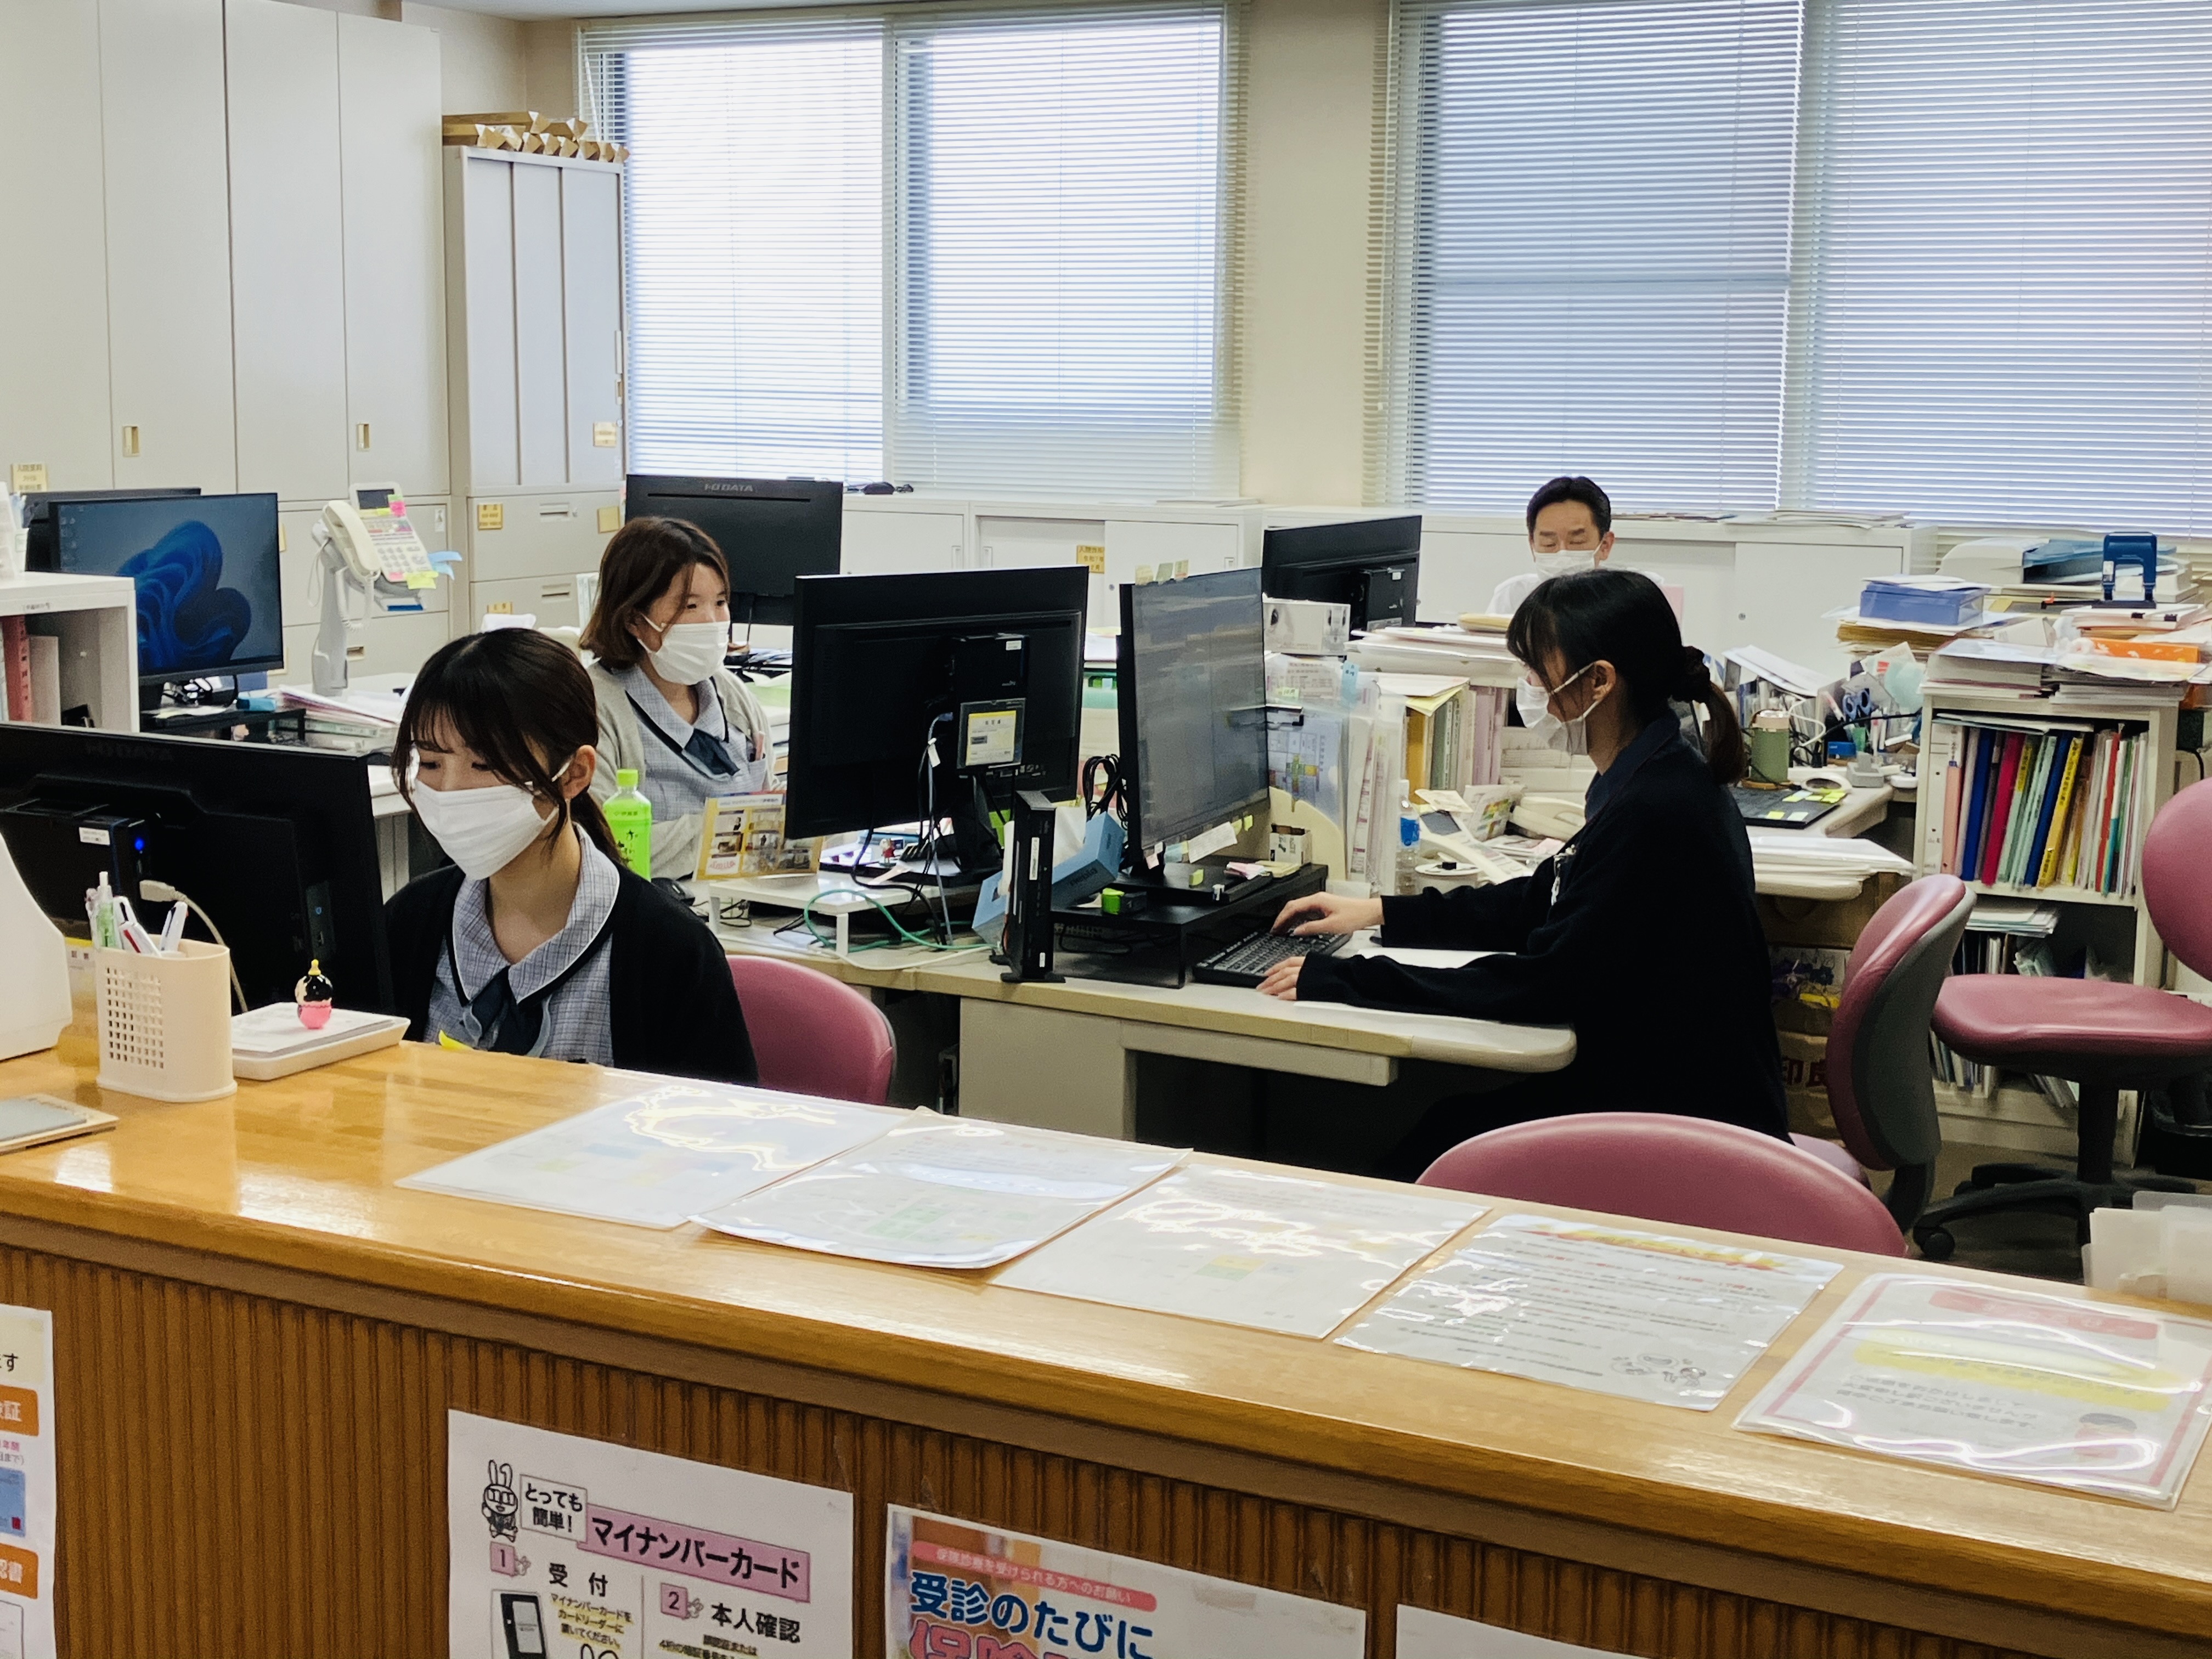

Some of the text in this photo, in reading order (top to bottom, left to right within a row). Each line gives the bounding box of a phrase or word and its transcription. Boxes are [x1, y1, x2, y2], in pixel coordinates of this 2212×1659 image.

[525, 1483, 583, 1512] とっても
[500, 1549, 506, 1568] 1
[592, 1517, 800, 1588] マイナンバーカード
[668, 1591, 680, 1610] 2
[911, 1572, 1154, 1659] 受診のたびに
[711, 1602, 800, 1644] 本人確認
